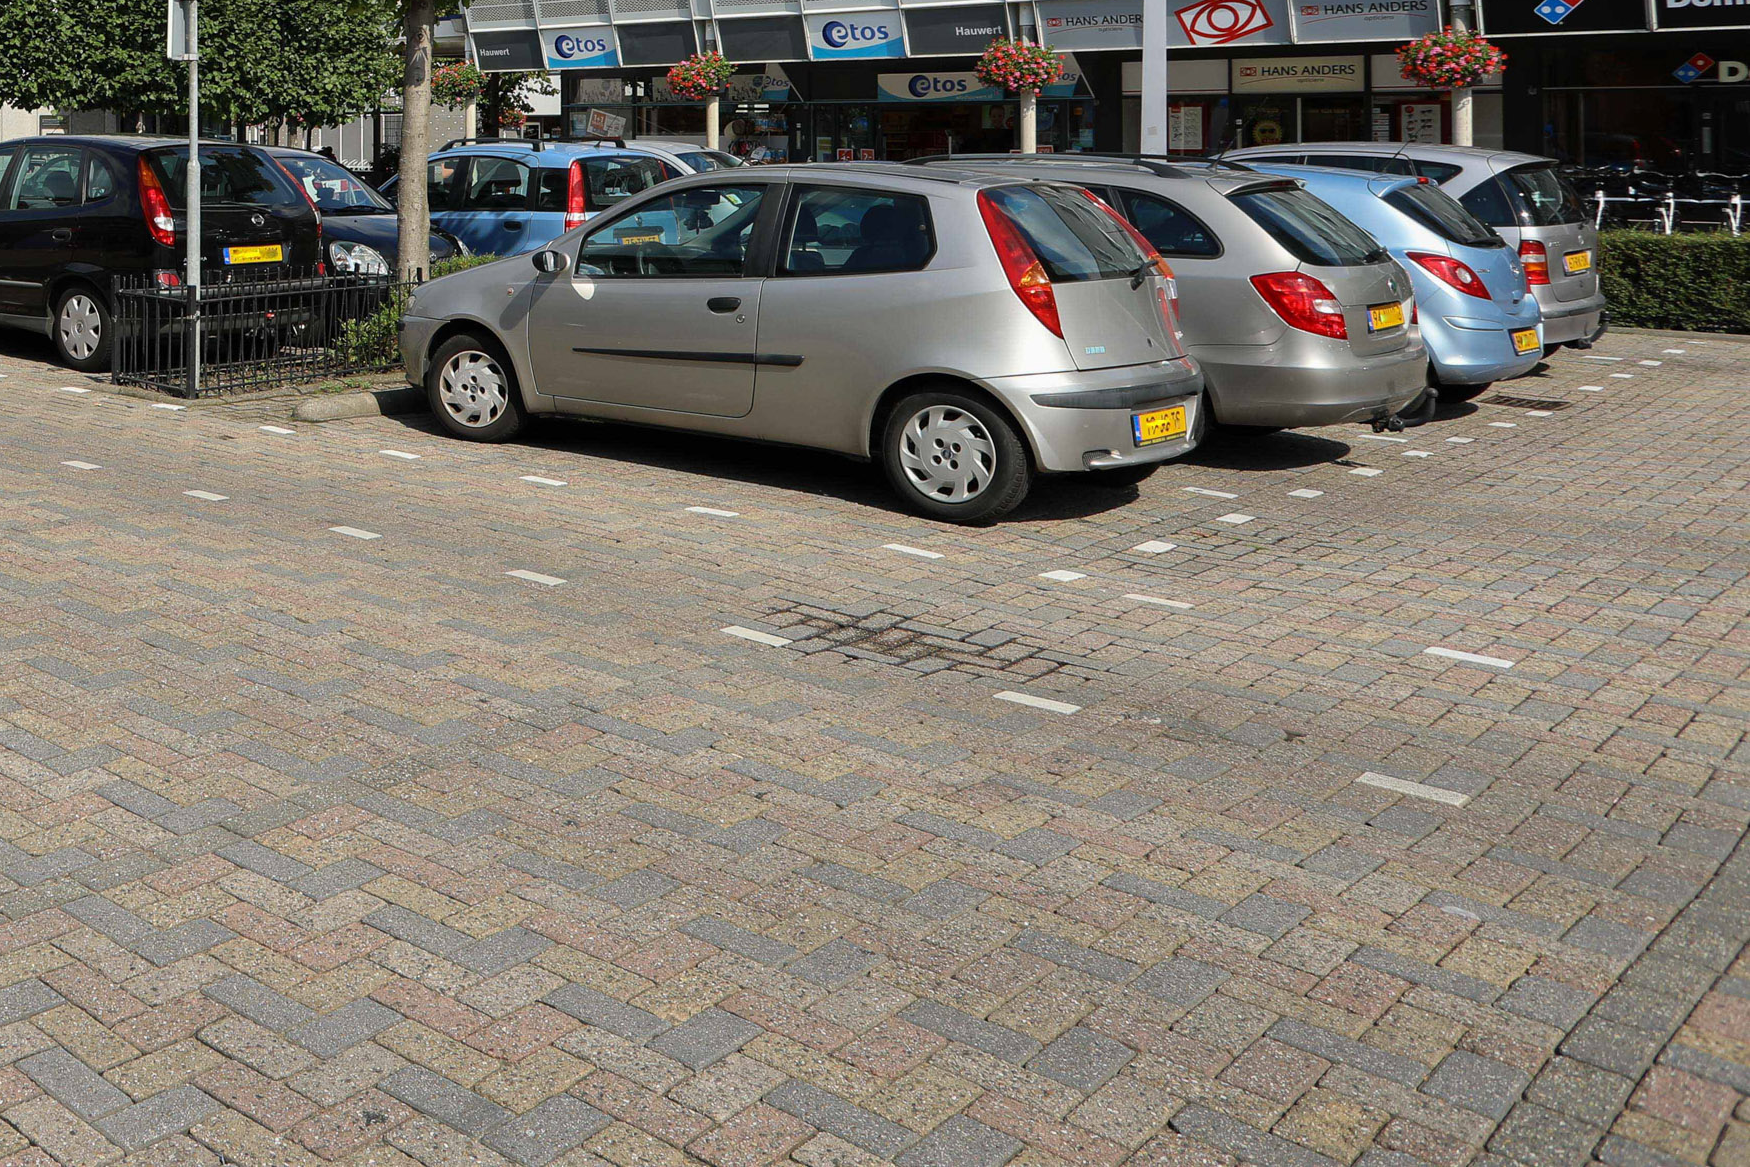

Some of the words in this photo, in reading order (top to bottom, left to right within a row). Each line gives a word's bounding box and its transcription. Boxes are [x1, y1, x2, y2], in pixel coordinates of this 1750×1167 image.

[1325, 3, 1364, 15] HANS
[1368, 0, 1428, 13] ANDERS
[1066, 15, 1098, 26] HANS
[1102, 14, 1143, 25] ANDER
[822, 20, 889, 48] etos
[955, 25, 1003, 37] Hauwert
[479, 48, 510, 57] Hauwert
[554, 34, 607, 59] etos
[1261, 65, 1298, 76] HANS
[1301, 64, 1356, 75] ANDERS
[908, 74, 967, 98] etos
